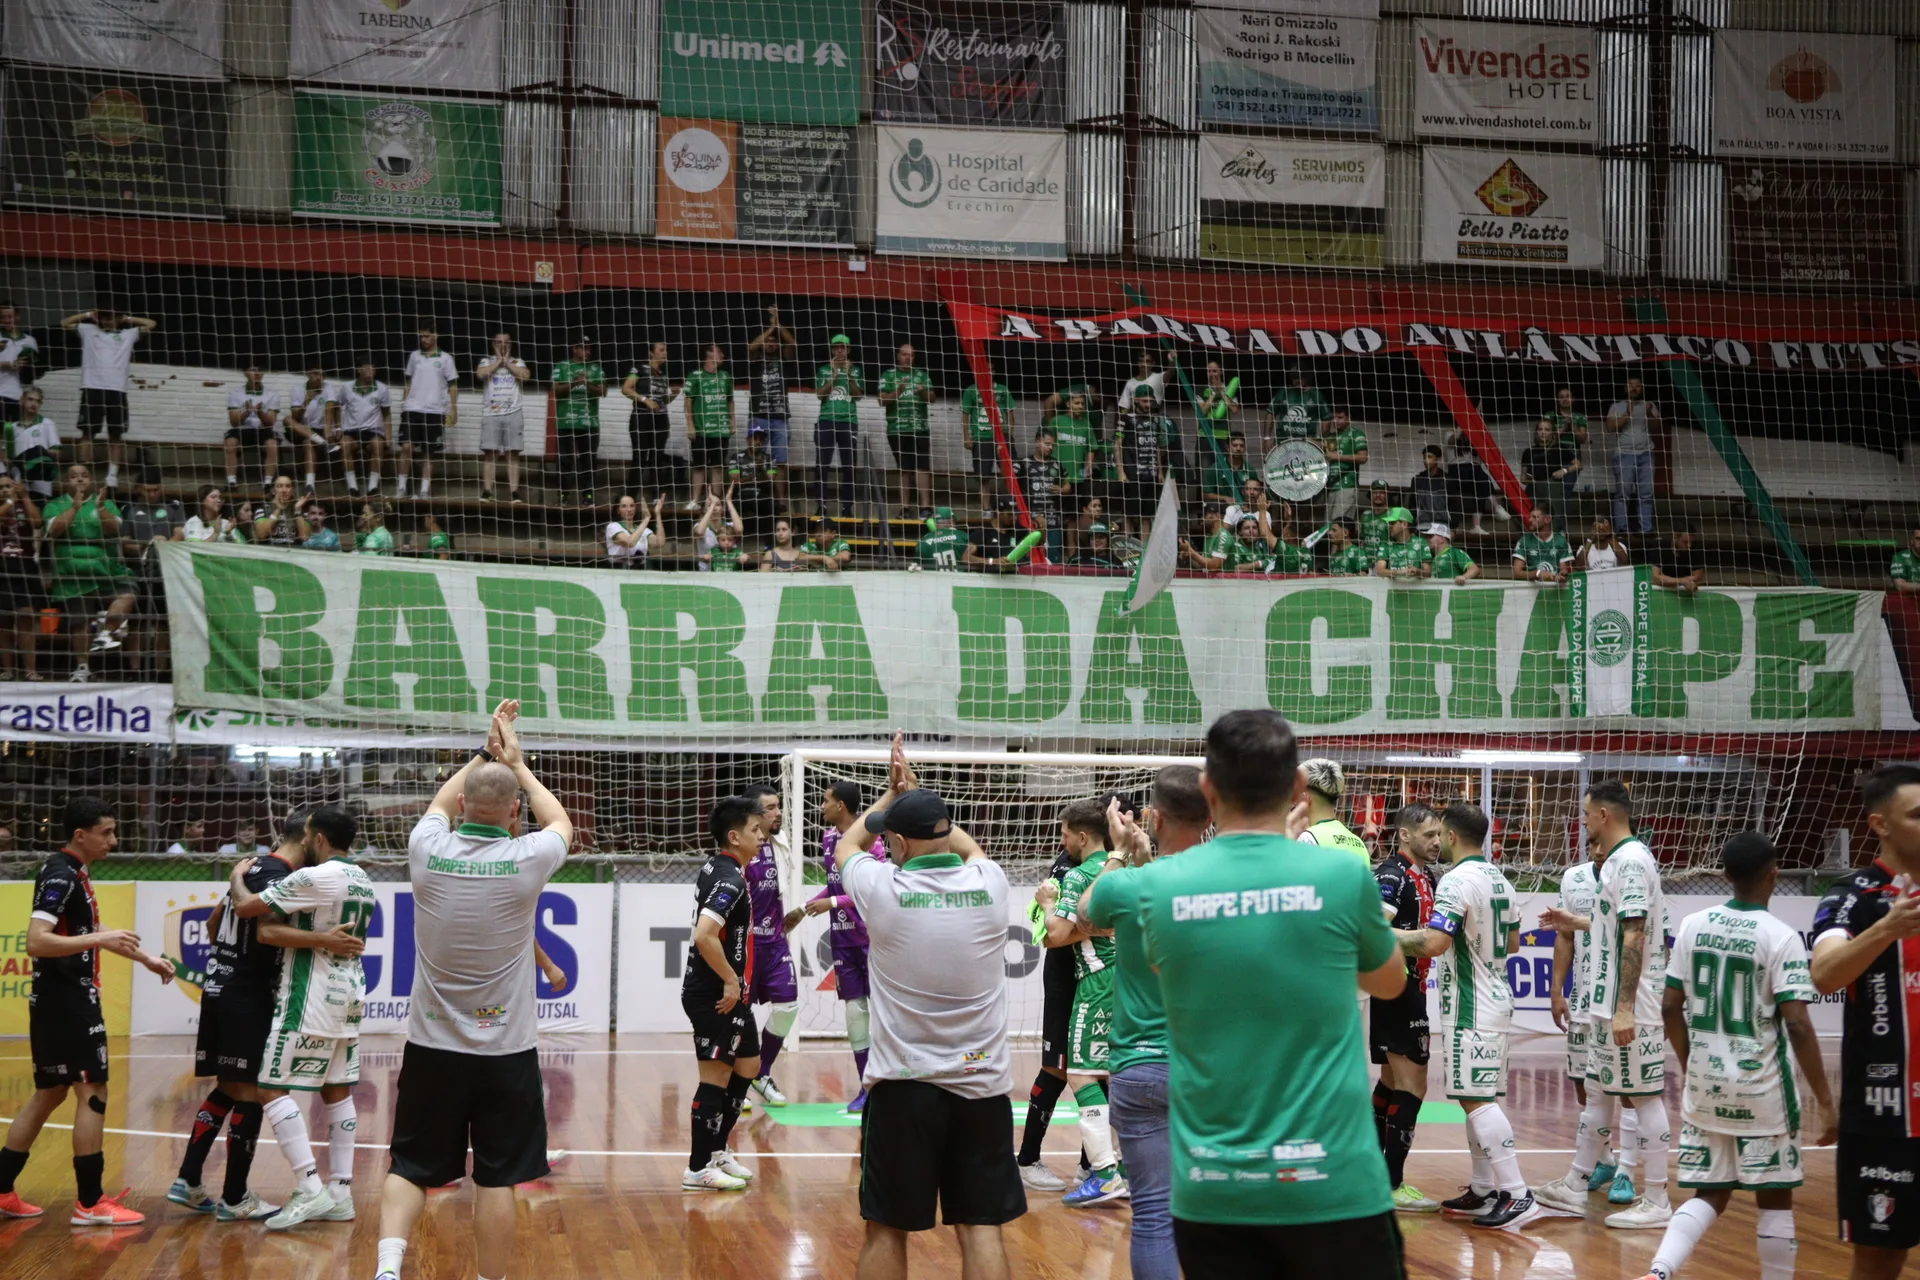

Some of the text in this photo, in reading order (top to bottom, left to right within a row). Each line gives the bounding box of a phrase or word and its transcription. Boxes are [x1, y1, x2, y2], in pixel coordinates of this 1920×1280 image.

[358, 12, 433, 29] TABERNA
[1242, 14, 1338, 30] Neri Omizzolo
[673, 31, 805, 64] Unimed
[927, 27, 1064, 63] Restaurante
[1240, 32, 1270, 44] Roni
[1273, 33, 1284, 45] J.
[1226, 47, 1355, 65] Rodrigo B Mocellin
[1420, 38, 1590, 80] Vivendas
[1211, 85, 1268, 101] Ortopedia
[1281, 90, 1363, 104] Traumatologia
[1509, 82, 1594, 101] HOTEL
[1213, 100, 1234, 112] (54)
[1766, 107, 1842, 121] BOA VISTA
[1421, 113, 1592, 131] www.vivendashotel.com.br
[744, 128, 766, 136] DOIS
[826, 132, 850, 140] PARA
[744, 139, 781, 148] MELHOR
[1719, 139, 1735, 148] RUA
[1766, 141, 1779, 149] 150
[1796, 142, 1823, 151] ANDAR
[948, 152, 1023, 175] Hospital
[1220, 158, 1277, 184] Carlos
[1292, 158, 1365, 173] SERVIMOS
[948, 175, 1059, 196] de Caridade
[1292, 173, 1328, 182] ALMOÇO
[1338, 174, 1365, 184] JANTA
[333, 191, 364, 202] Fone:
[368, 193, 391, 205] (54)
[947, 201, 1014, 213] Erechim
[1458, 219, 1569, 241] Bello Piatto
[1460, 246, 1512, 257] Restaurante
[1514, 250, 1519, 258] &
[1000, 314, 1042, 340] A
[1054, 313, 1280, 354] BARRA
[1295, 327, 1383, 356] DO
[1405, 322, 1752, 366] ATLÂNTICO
[192, 552, 889, 721] BARRA
[950, 586, 1202, 723] DA
[1265, 587, 1858, 723] CHAPE
[1572, 579, 1582, 703] BARRA DA CHAPE
[1636, 581, 1648, 691] CHAPE FUTSAL
[0, 695, 150, 732] astelha
[427, 855, 520, 875] CHAPE FUTSAL
[900, 890, 994, 909] CHAPE FUTSAL
[1172, 885, 1323, 921] CHAPE FUTSAL
[1444, 919, 1456, 932] C
[1719, 915, 1758, 930] SICOOB
[735, 926, 744, 961] Orbenk
[1691, 950, 1757, 1038] 90
[1812, 989, 1846, 1004] e/cbf
[538, 1003, 579, 1018] UTSAL
[1872, 972, 1890, 1036] Orbenk
[1073, 1003, 1089, 1063] Unimed
[269, 1030, 289, 1078] imed
[1453, 1026, 1465, 1090] Unimed
[1620, 1046, 1634, 1088] imed
[1865, 1086, 1901, 1116] 44
[1714, 1107, 1755, 1120] BRASIL
